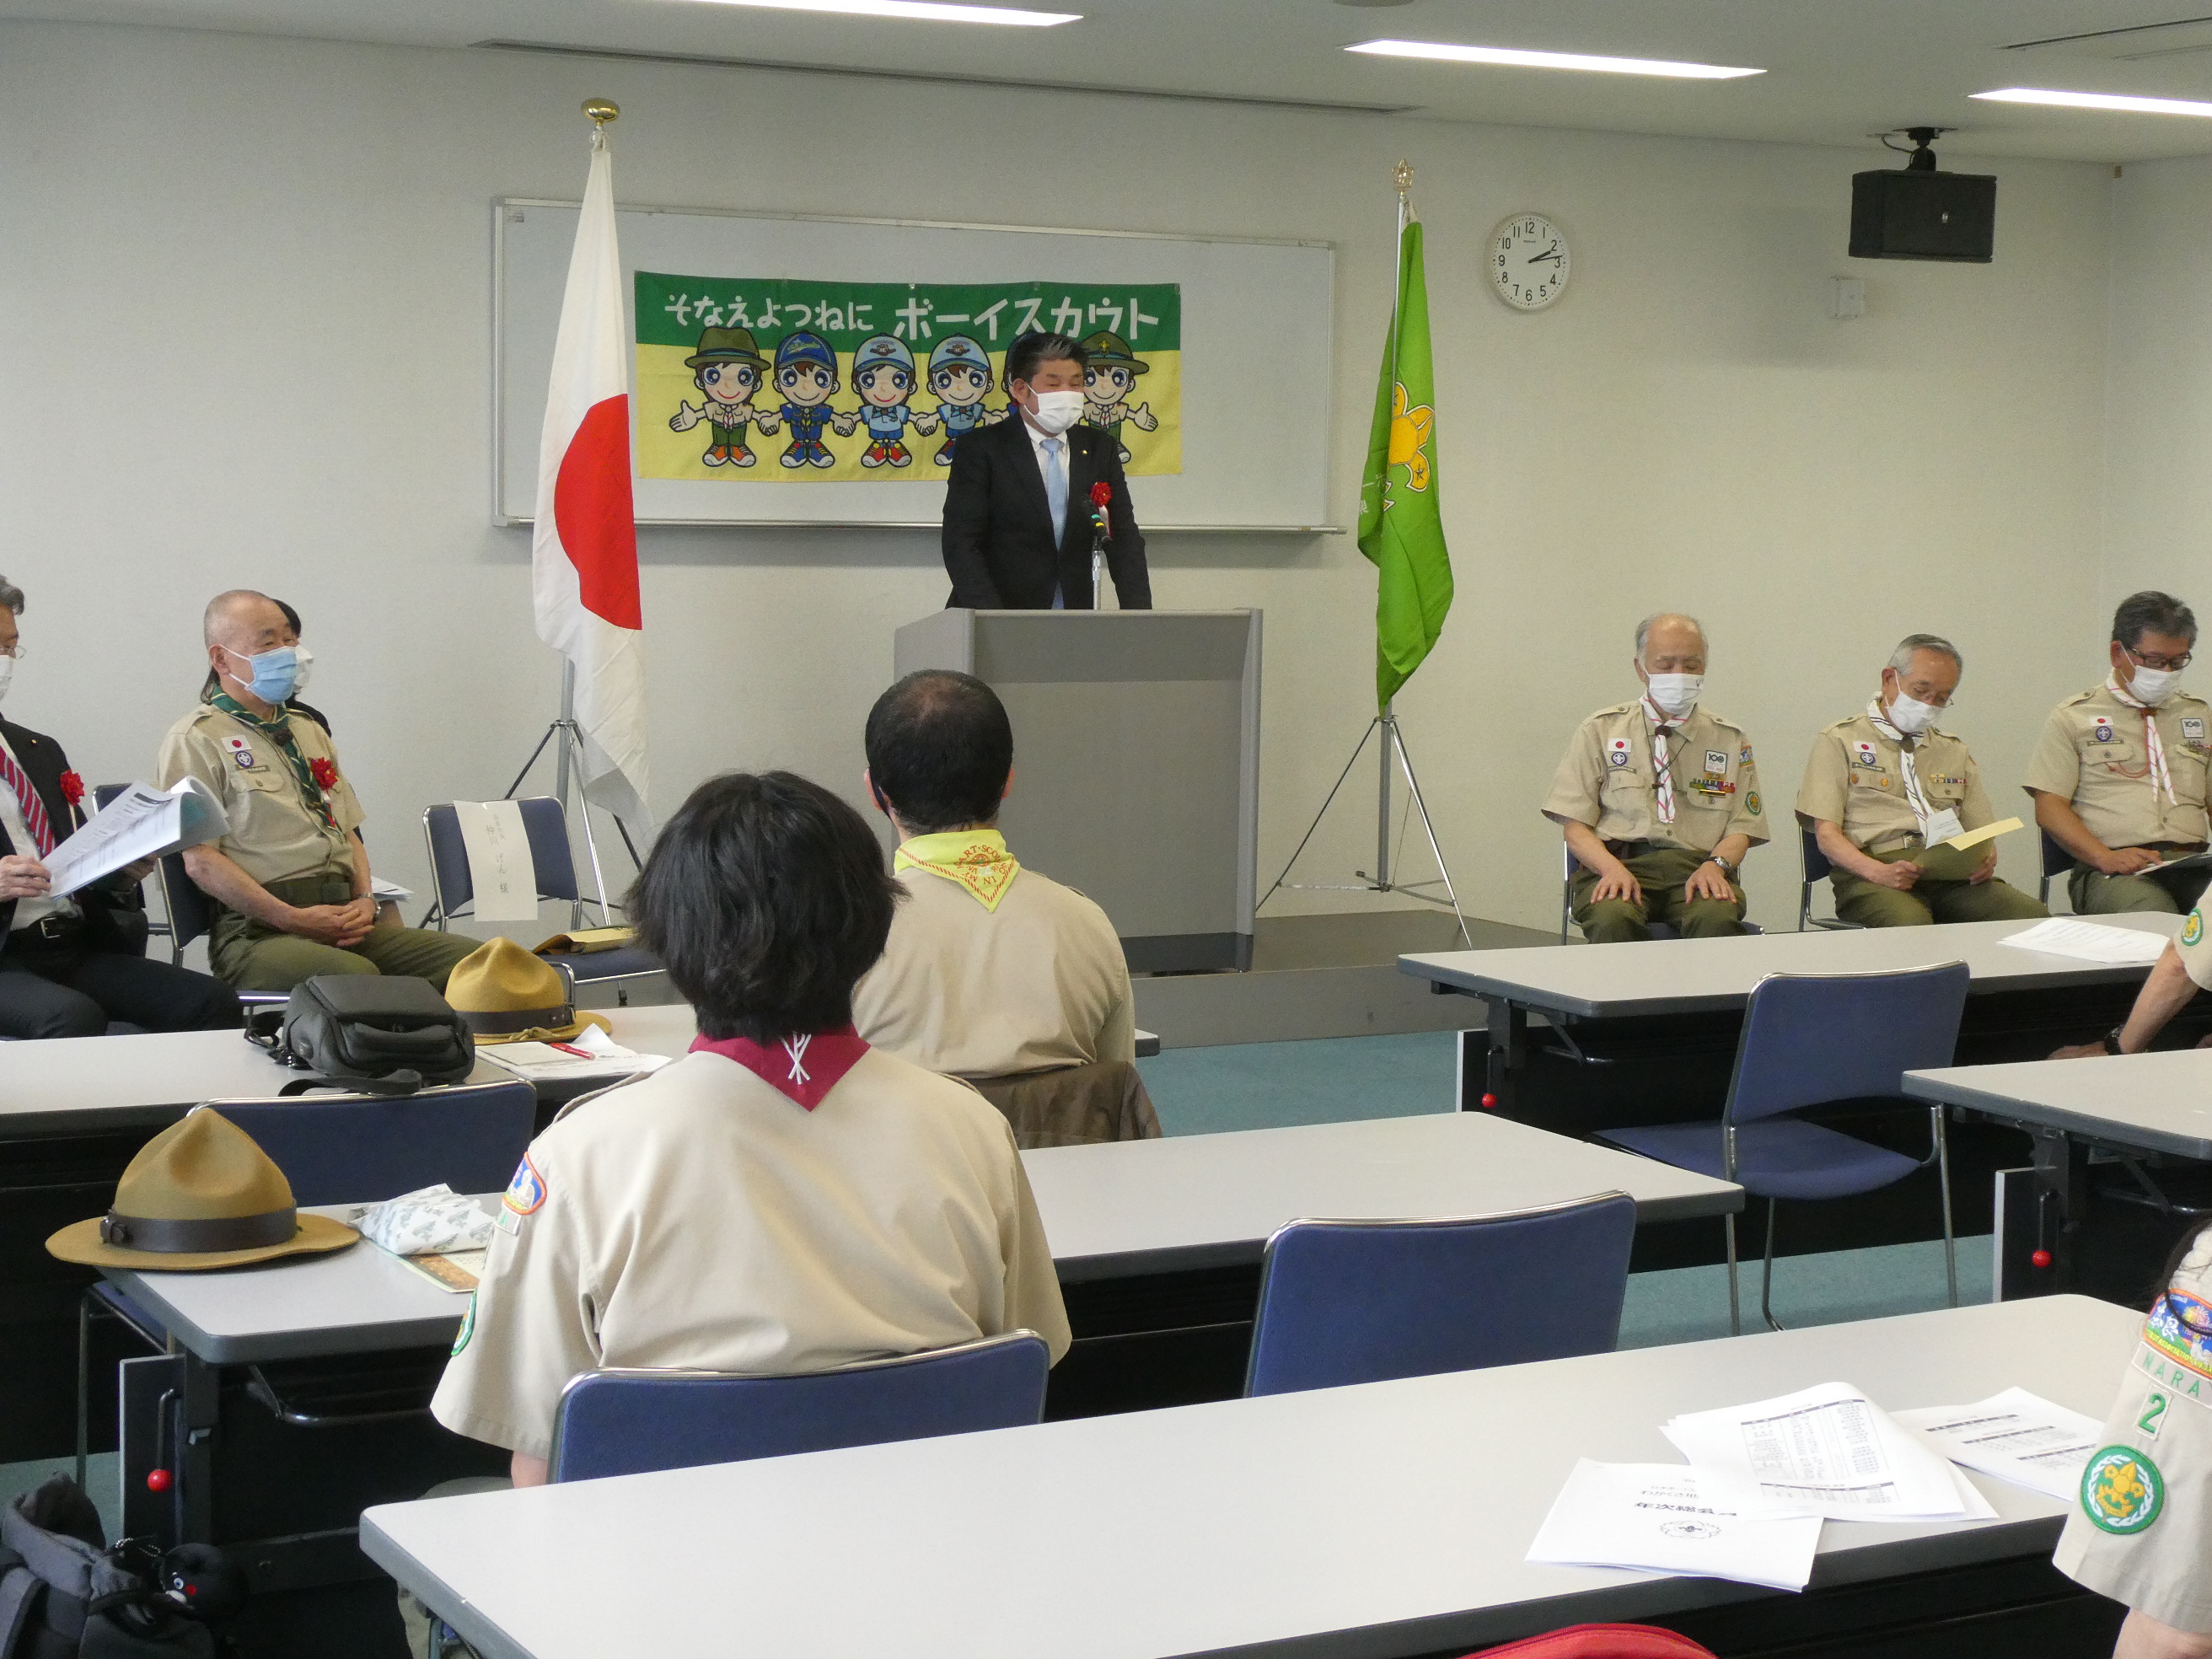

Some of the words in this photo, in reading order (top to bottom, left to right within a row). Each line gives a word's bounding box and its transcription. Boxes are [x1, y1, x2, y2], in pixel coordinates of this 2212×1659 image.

[1513, 225, 1521, 238] 11
[1525, 221, 1535, 234] 12
[1502, 237, 1511, 250] 10
[1551, 239, 1557, 251] 2
[1498, 255, 1506, 266] 9
[1554, 256, 1560, 268] 3
[1501, 271, 1508, 283] 8
[1549, 273, 1556, 285] 4
[1512, 284, 1520, 296] 7
[1525, 289, 1533, 301] 6
[1539, 285, 1547, 297] 5
[664, 293, 874, 331] そなえよつねに
[893, 295, 1159, 341] ボーイスカウト
[2142, 1350, 2200, 1399] NARA
[2138, 1393, 2166, 1434] 2
